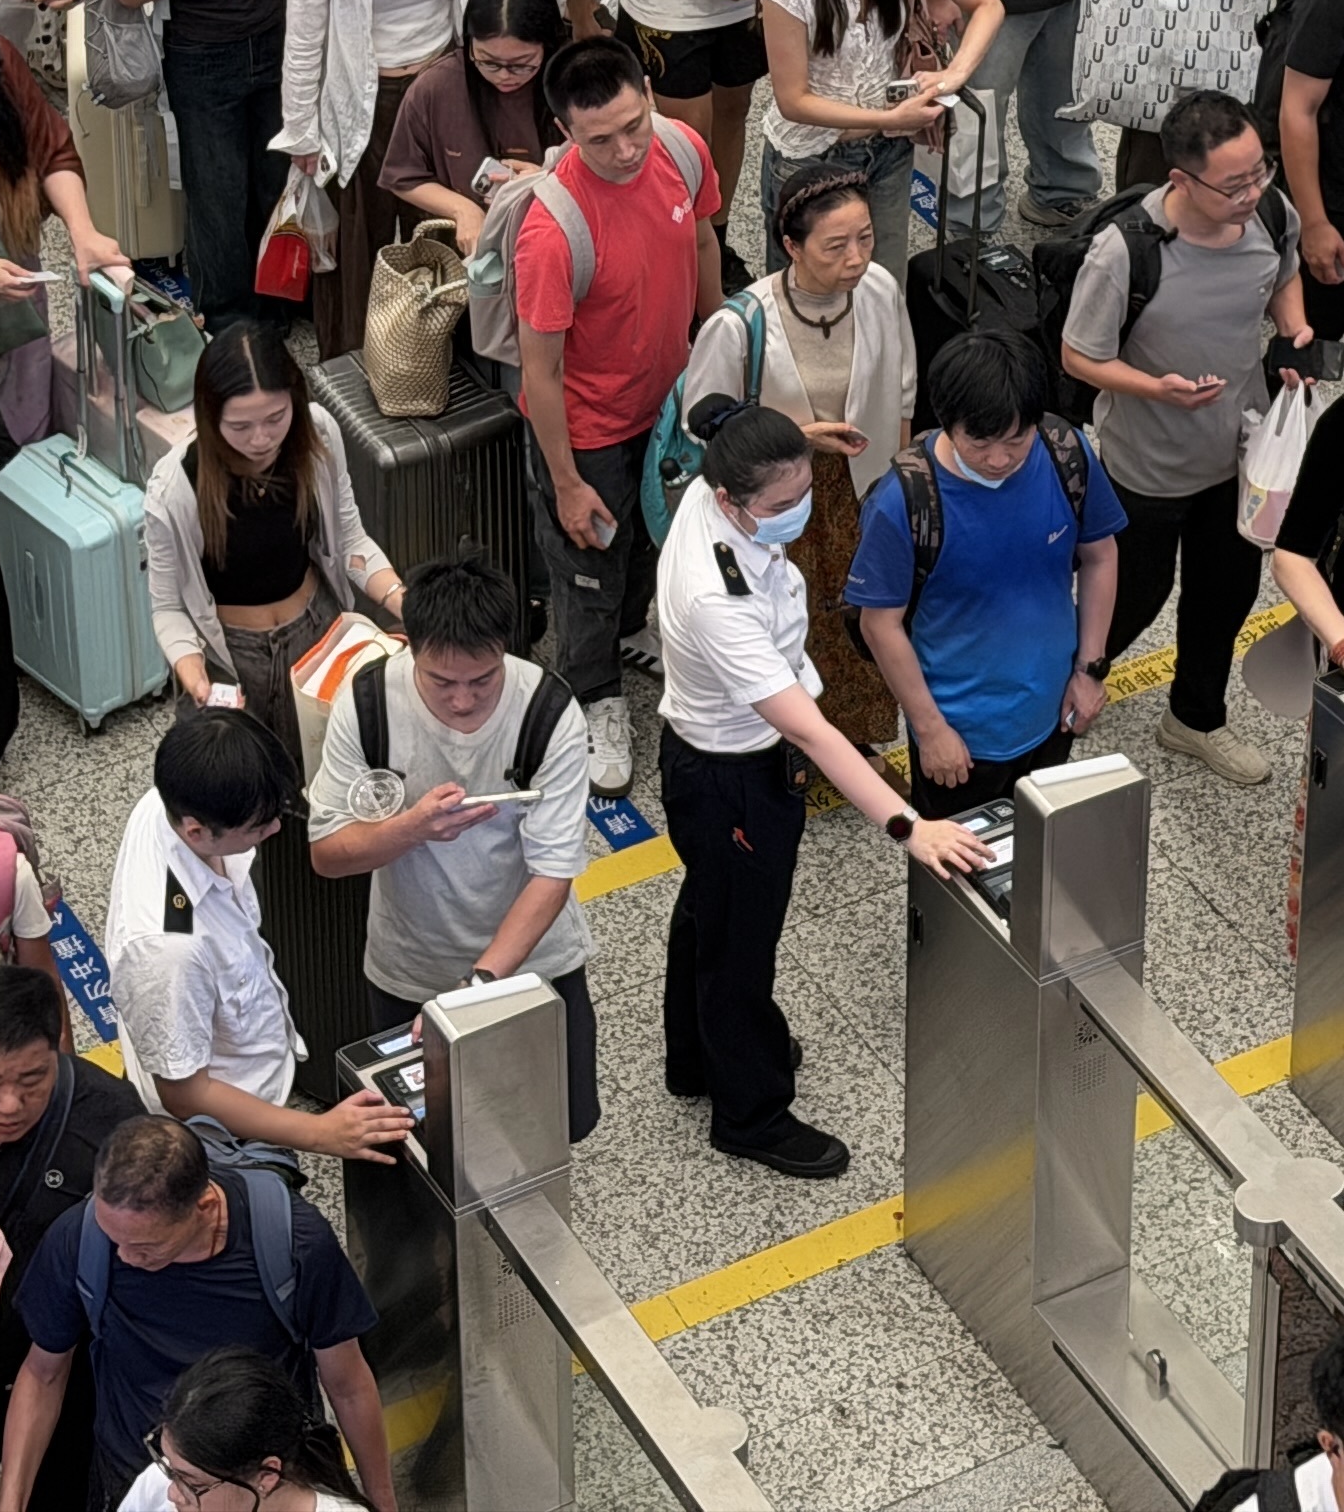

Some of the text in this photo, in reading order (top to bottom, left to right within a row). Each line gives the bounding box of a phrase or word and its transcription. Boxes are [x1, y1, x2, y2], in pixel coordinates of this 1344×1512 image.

[910, 178, 939, 223] 检票
[1106, 660, 1176, 698] 排队
[49, 912, 120, 1026] 请勿冲撞
